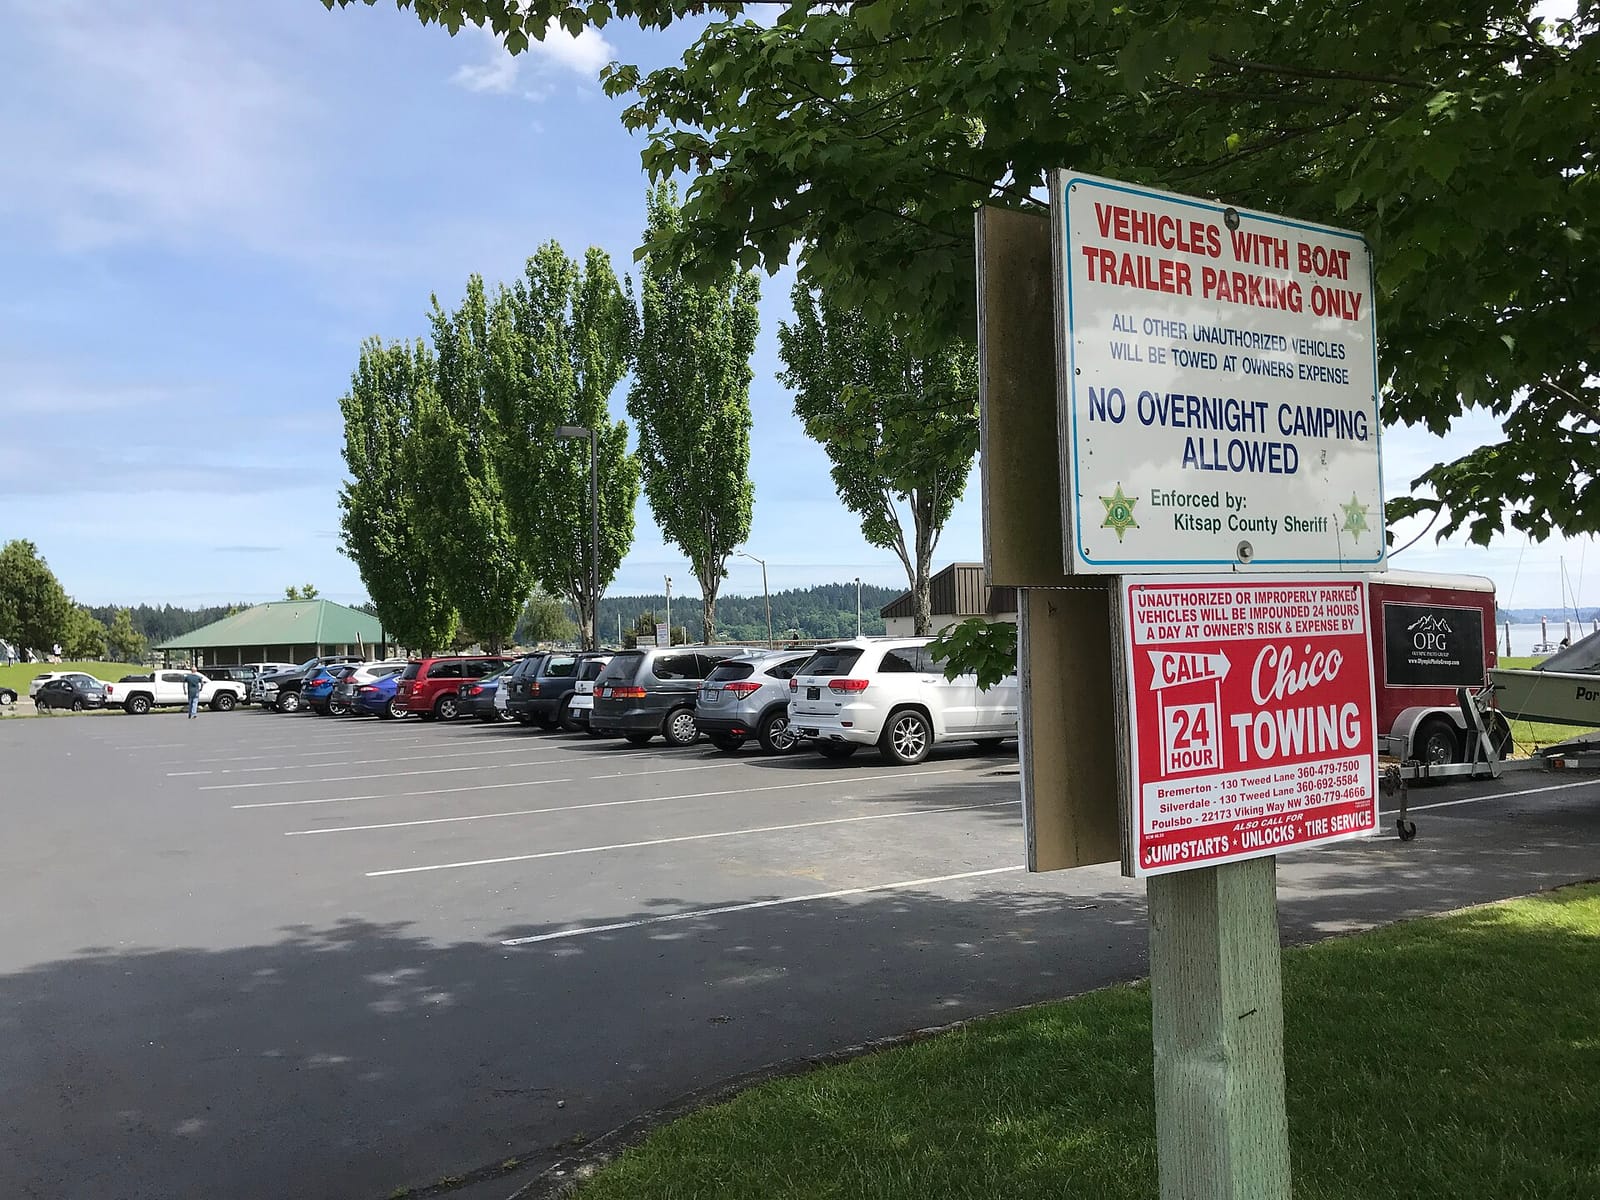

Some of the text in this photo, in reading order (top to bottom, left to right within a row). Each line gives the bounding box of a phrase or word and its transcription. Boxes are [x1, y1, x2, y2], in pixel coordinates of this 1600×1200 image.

[1095, 202, 1350, 280] VEHICLES WITH BOAT
[1082, 246, 1362, 321] TRAILER PARKING ONLY
[1113, 314, 1345, 360] ALL OTHER UNAUTHORIZED VEHICLES
[1110, 342, 1349, 384] WILL BE TOWED AT OWNERS EXPENSE
[1088, 386, 1368, 441] NO OVERNIGHT CAMPING
[1182, 436, 1299, 474] ALLOWED
[1151, 489, 1247, 510] Enforced by:
[1174, 513, 1327, 535] Kitsap County Sheriff
[1138, 589, 1357, 607] UNAUTHORIZED OR IMPROPERLY PARKED
[1138, 604, 1359, 623] VEHICLES WILL BE IMPOUNDED 24 HOURS
[1146, 619, 1354, 640] A DAY AT OWNER'S RISK & EXPENSE BY
[1414, 633, 1446, 650] OPG
[1162, 655, 1215, 684] CALL
[1252, 644, 1343, 705] Chico
[1576, 687, 1599, 701] Por
[1172, 707, 1209, 749] 24
[1230, 703, 1361, 763] TOWING
[1158, 783, 1211, 798] Bremerton
[1221, 779, 1238, 790] 130
[1241, 774, 1271, 787] Tweed
[1274, 772, 1295, 783] Lane
[1297, 759, 1359, 779] 360-479-7500
[1171, 750, 1213, 769] HOUR
[1152, 817, 1192, 830] Poulsbo
[1201, 810, 1232, 823] 22173
[1234, 805, 1264, 818] Viking
[1266, 800, 1285, 813] Way
[1287, 798, 1302, 809] NW
[1304, 786, 1365, 806] 360-779-4666
[1160, 798, 1210, 813] Silverdale
[1220, 794, 1237, 805] 130
[1239, 789, 1270, 802] Tweed
[1273, 786, 1294, 797] Lane
[1296, 774, 1359, 793] 360-692-5584
[1233, 813, 1303, 831] ALSO CALL FOR
[1241, 824, 1295, 848] UNLOCKS
[1305, 820, 1328, 836] TIRE
[1331, 810, 1371, 832] SERVICE
